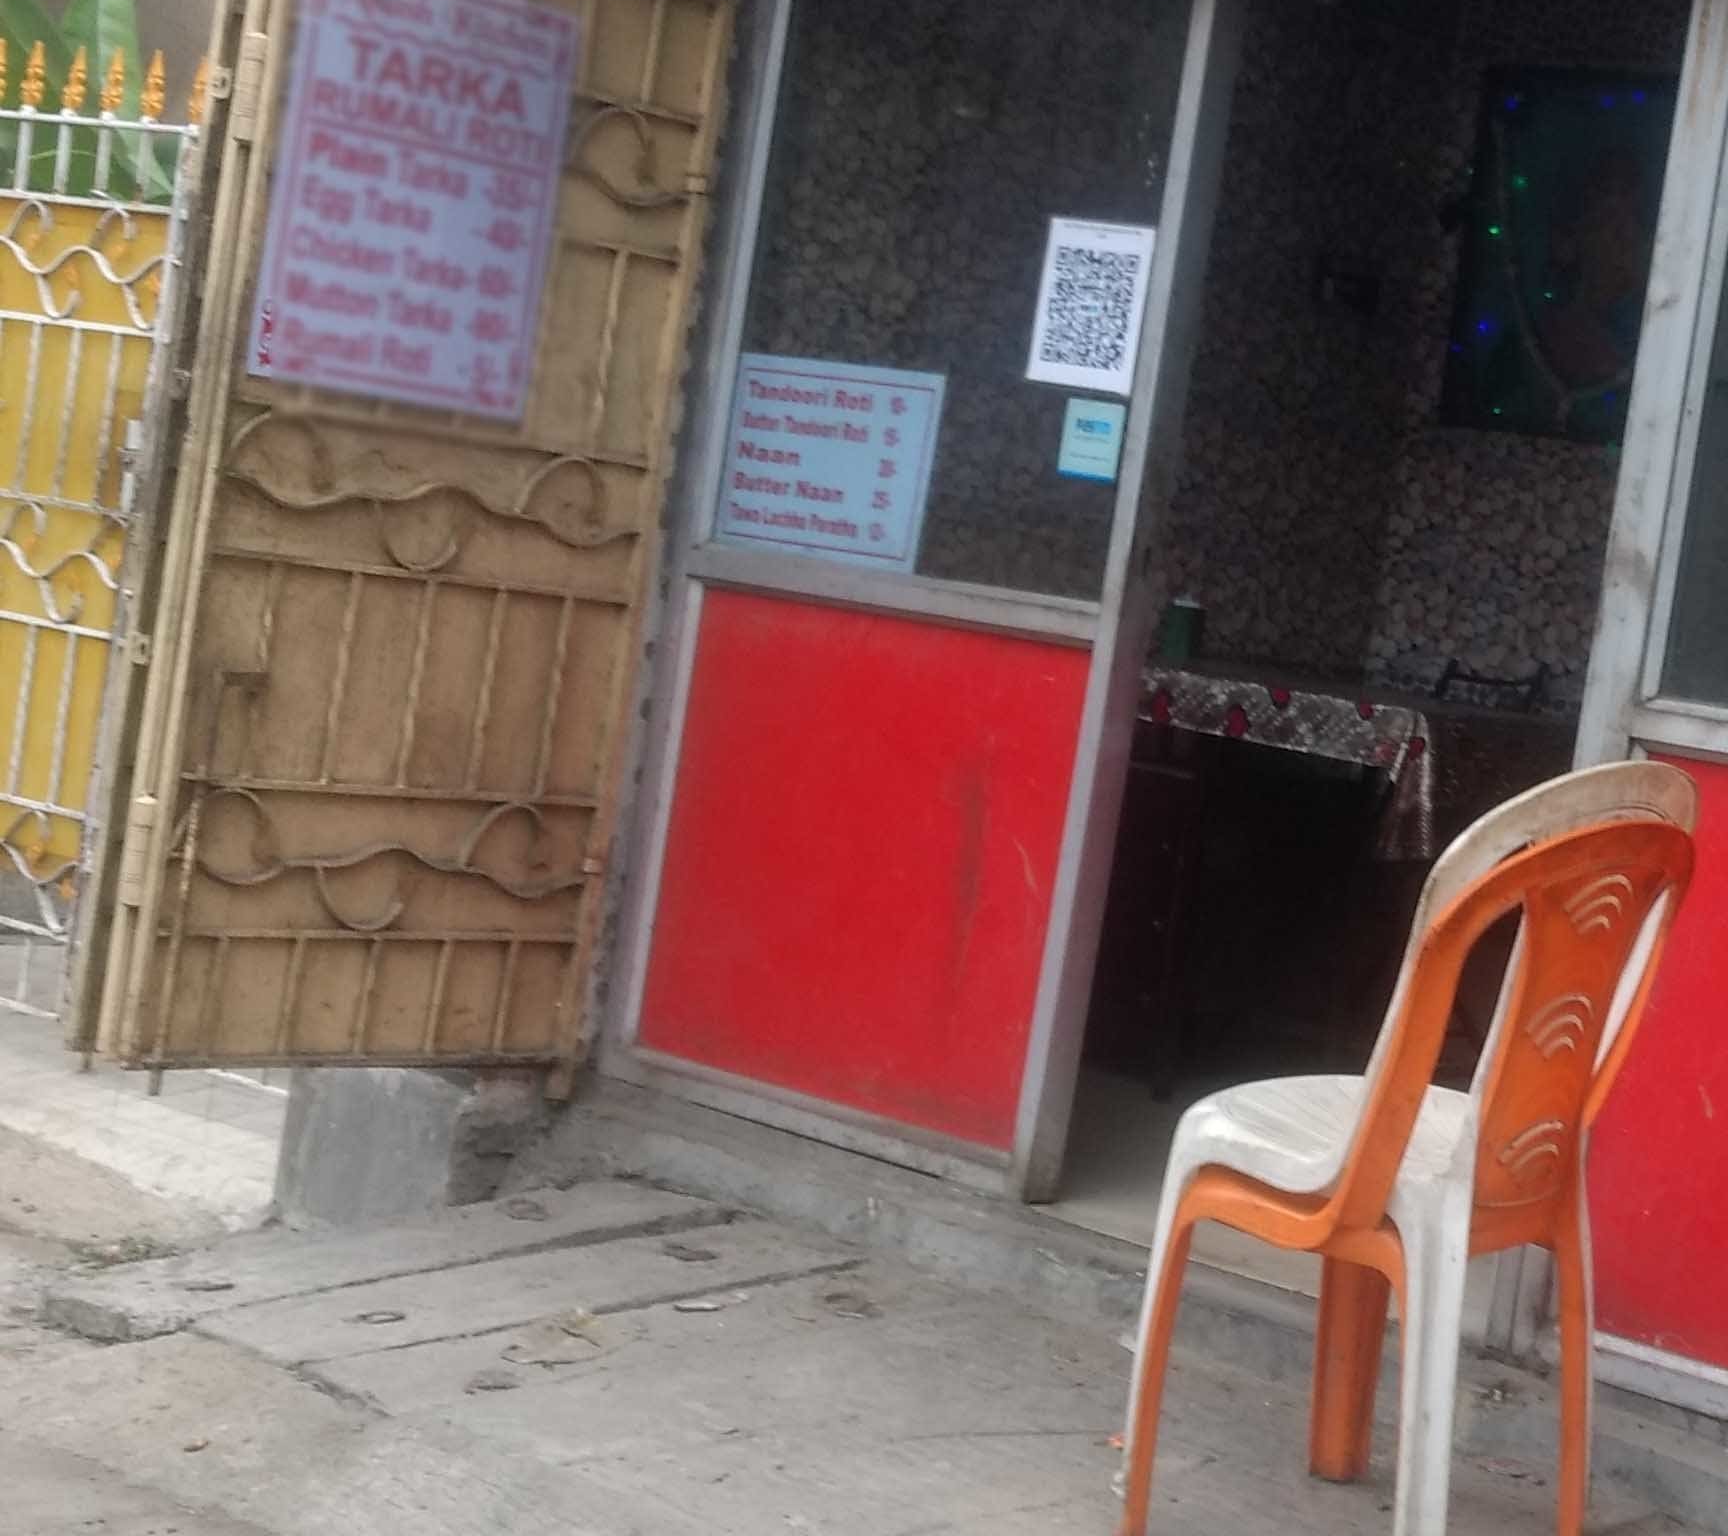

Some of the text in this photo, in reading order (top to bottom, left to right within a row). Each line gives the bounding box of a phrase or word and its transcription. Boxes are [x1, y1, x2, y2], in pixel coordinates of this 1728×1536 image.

[348, 32, 526, 122] TARKA
[308, 76, 555, 164] RUMALI ROTI
[309, 130, 389, 177] Plain
[398, 146, 470, 200] Tarka
[304, 173, 356, 226] Egg
[364, 187, 433, 234] Tarka
[387, 288, 454, 335] Tarka
[749, 378, 829, 407] Tandoori
[833, 389, 874, 412] Roti
[737, 440, 801, 465] Naan
[734, 471, 791, 496] Butter
[796, 479, 844, 504] Naan
